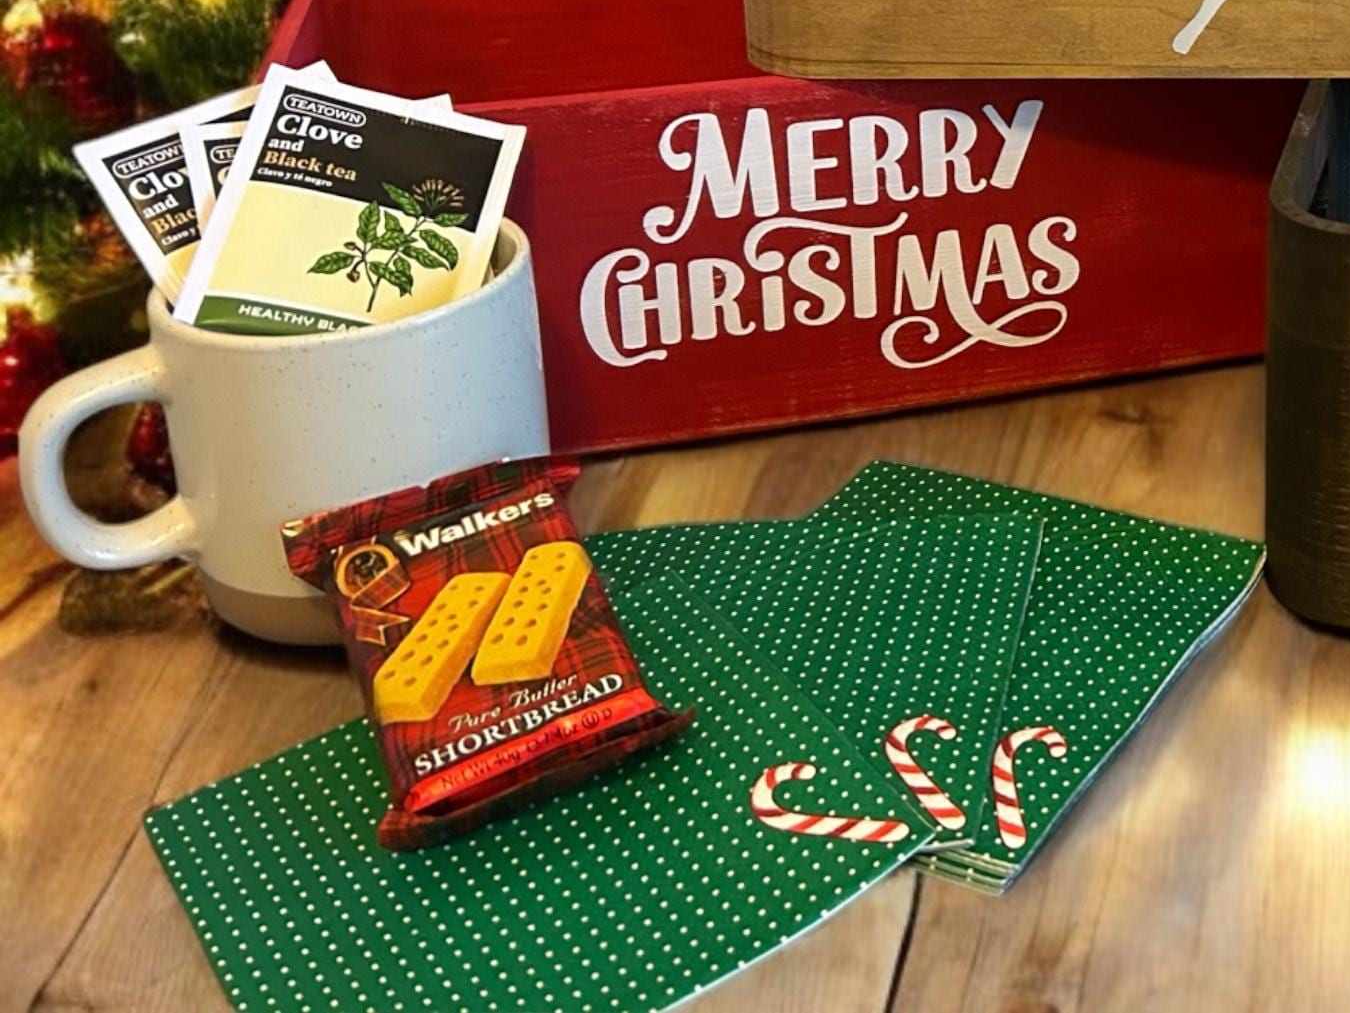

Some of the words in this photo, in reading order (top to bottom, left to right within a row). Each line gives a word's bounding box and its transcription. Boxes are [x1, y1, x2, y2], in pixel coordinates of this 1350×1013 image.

[290, 97, 362, 124] TEATOWN
[268, 138, 304, 152] and
[277, 114, 363, 149] Clove
[263, 151, 323, 173] Black
[325, 162, 357, 181] tea
[304, 176, 333, 188] negro
[643, 99, 1044, 244] MERRY
[128, 168, 190, 200] Clo
[142, 194, 179, 219] and
[580, 212, 1080, 369] CHRISTMAS
[238, 304, 314, 327] HEALTHY
[398, 493, 555, 557] Walkers
[448, 706, 502, 734] Pure
[509, 674, 577, 709] Butter
[414, 674, 623, 776] SHORTBREAD
